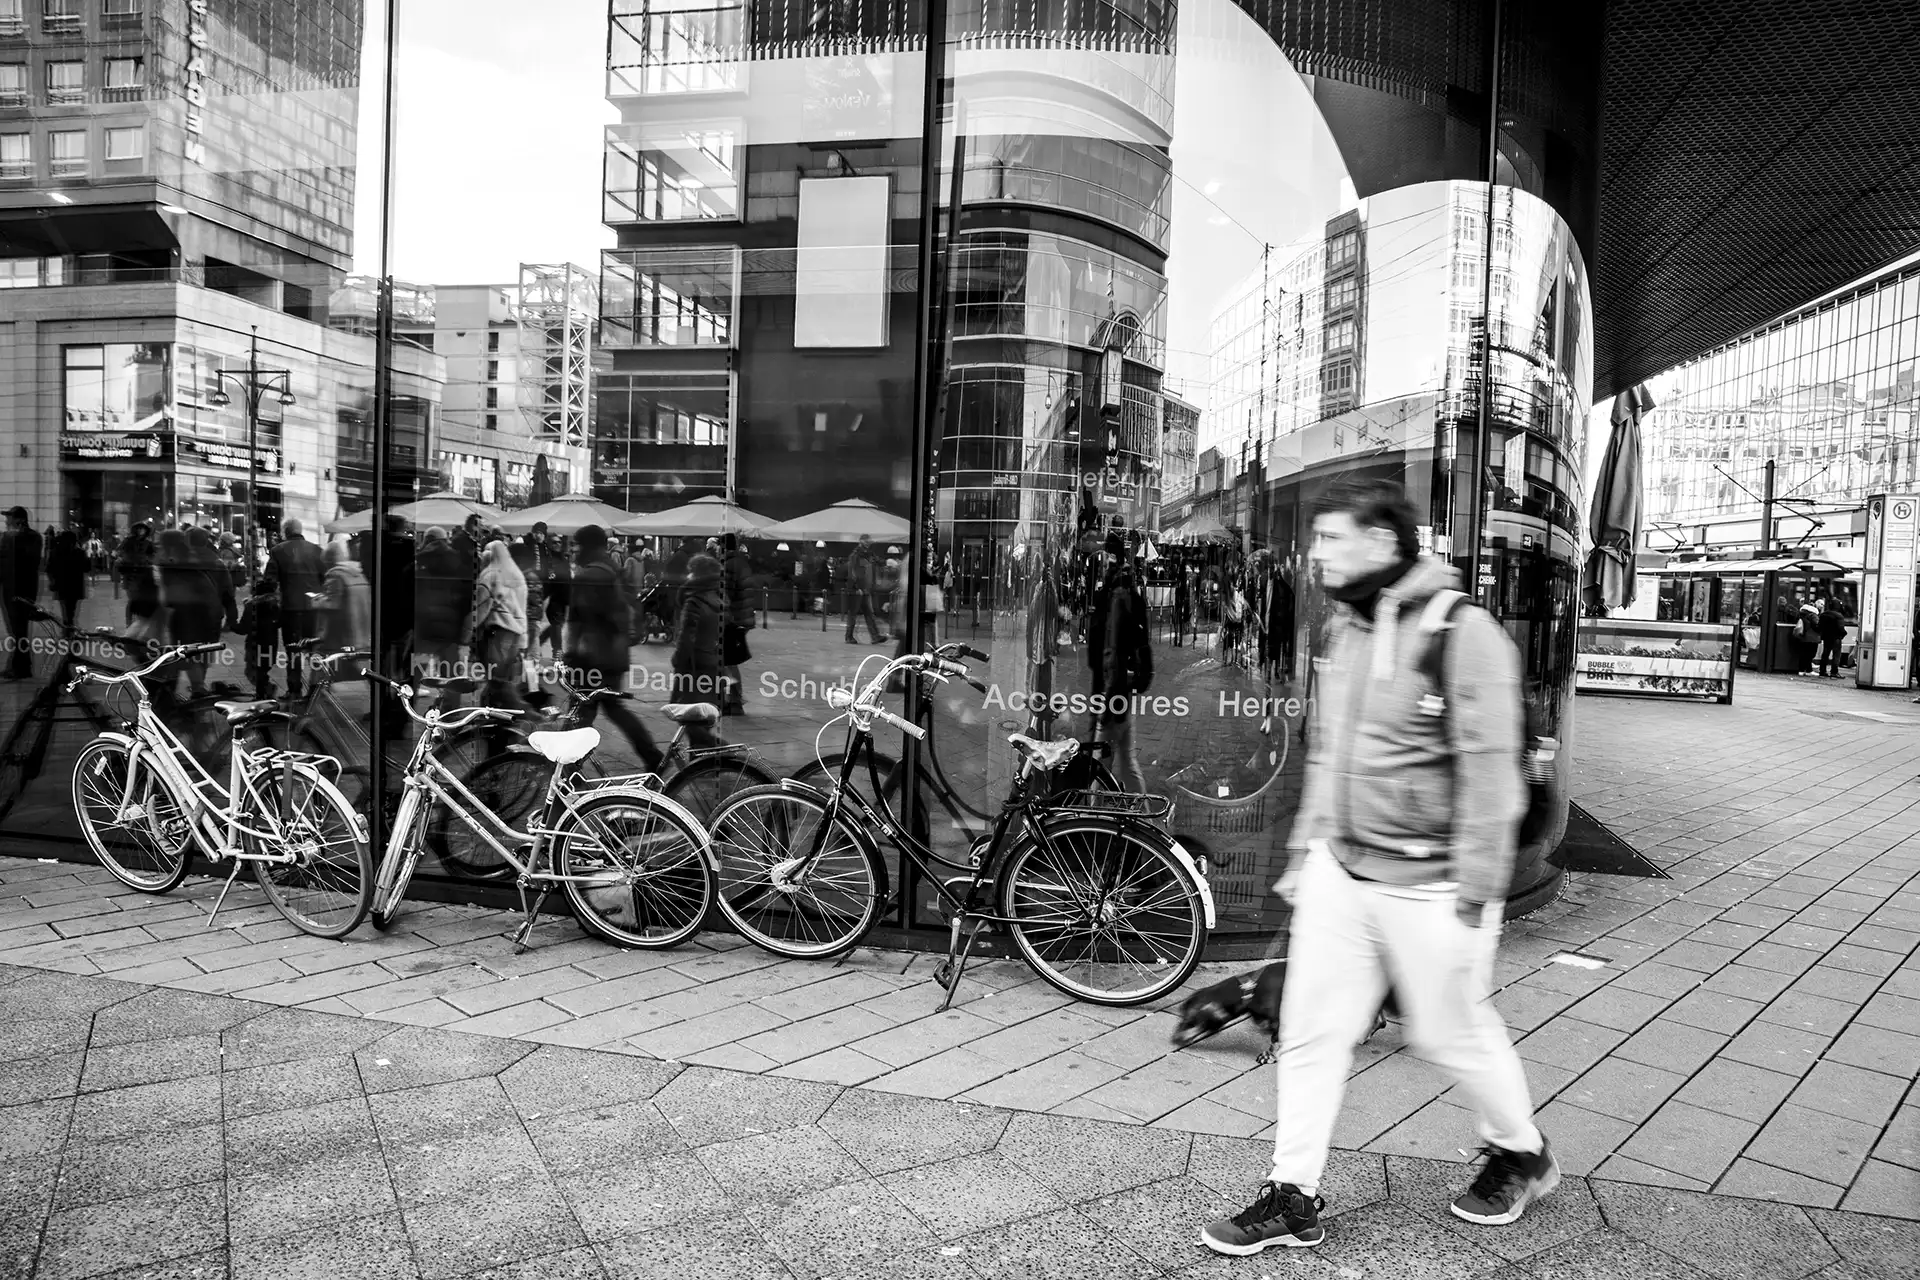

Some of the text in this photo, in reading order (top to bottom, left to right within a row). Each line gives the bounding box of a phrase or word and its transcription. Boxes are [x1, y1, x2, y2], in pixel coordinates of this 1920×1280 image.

[0, 635, 126, 659] ccessoires
[410, 652, 498, 681] Kinder
[629, 664, 732, 695] Damen
[1587, 660, 1615, 669] BUBBLE
[982, 683, 1318, 718] Accessoires Herren
